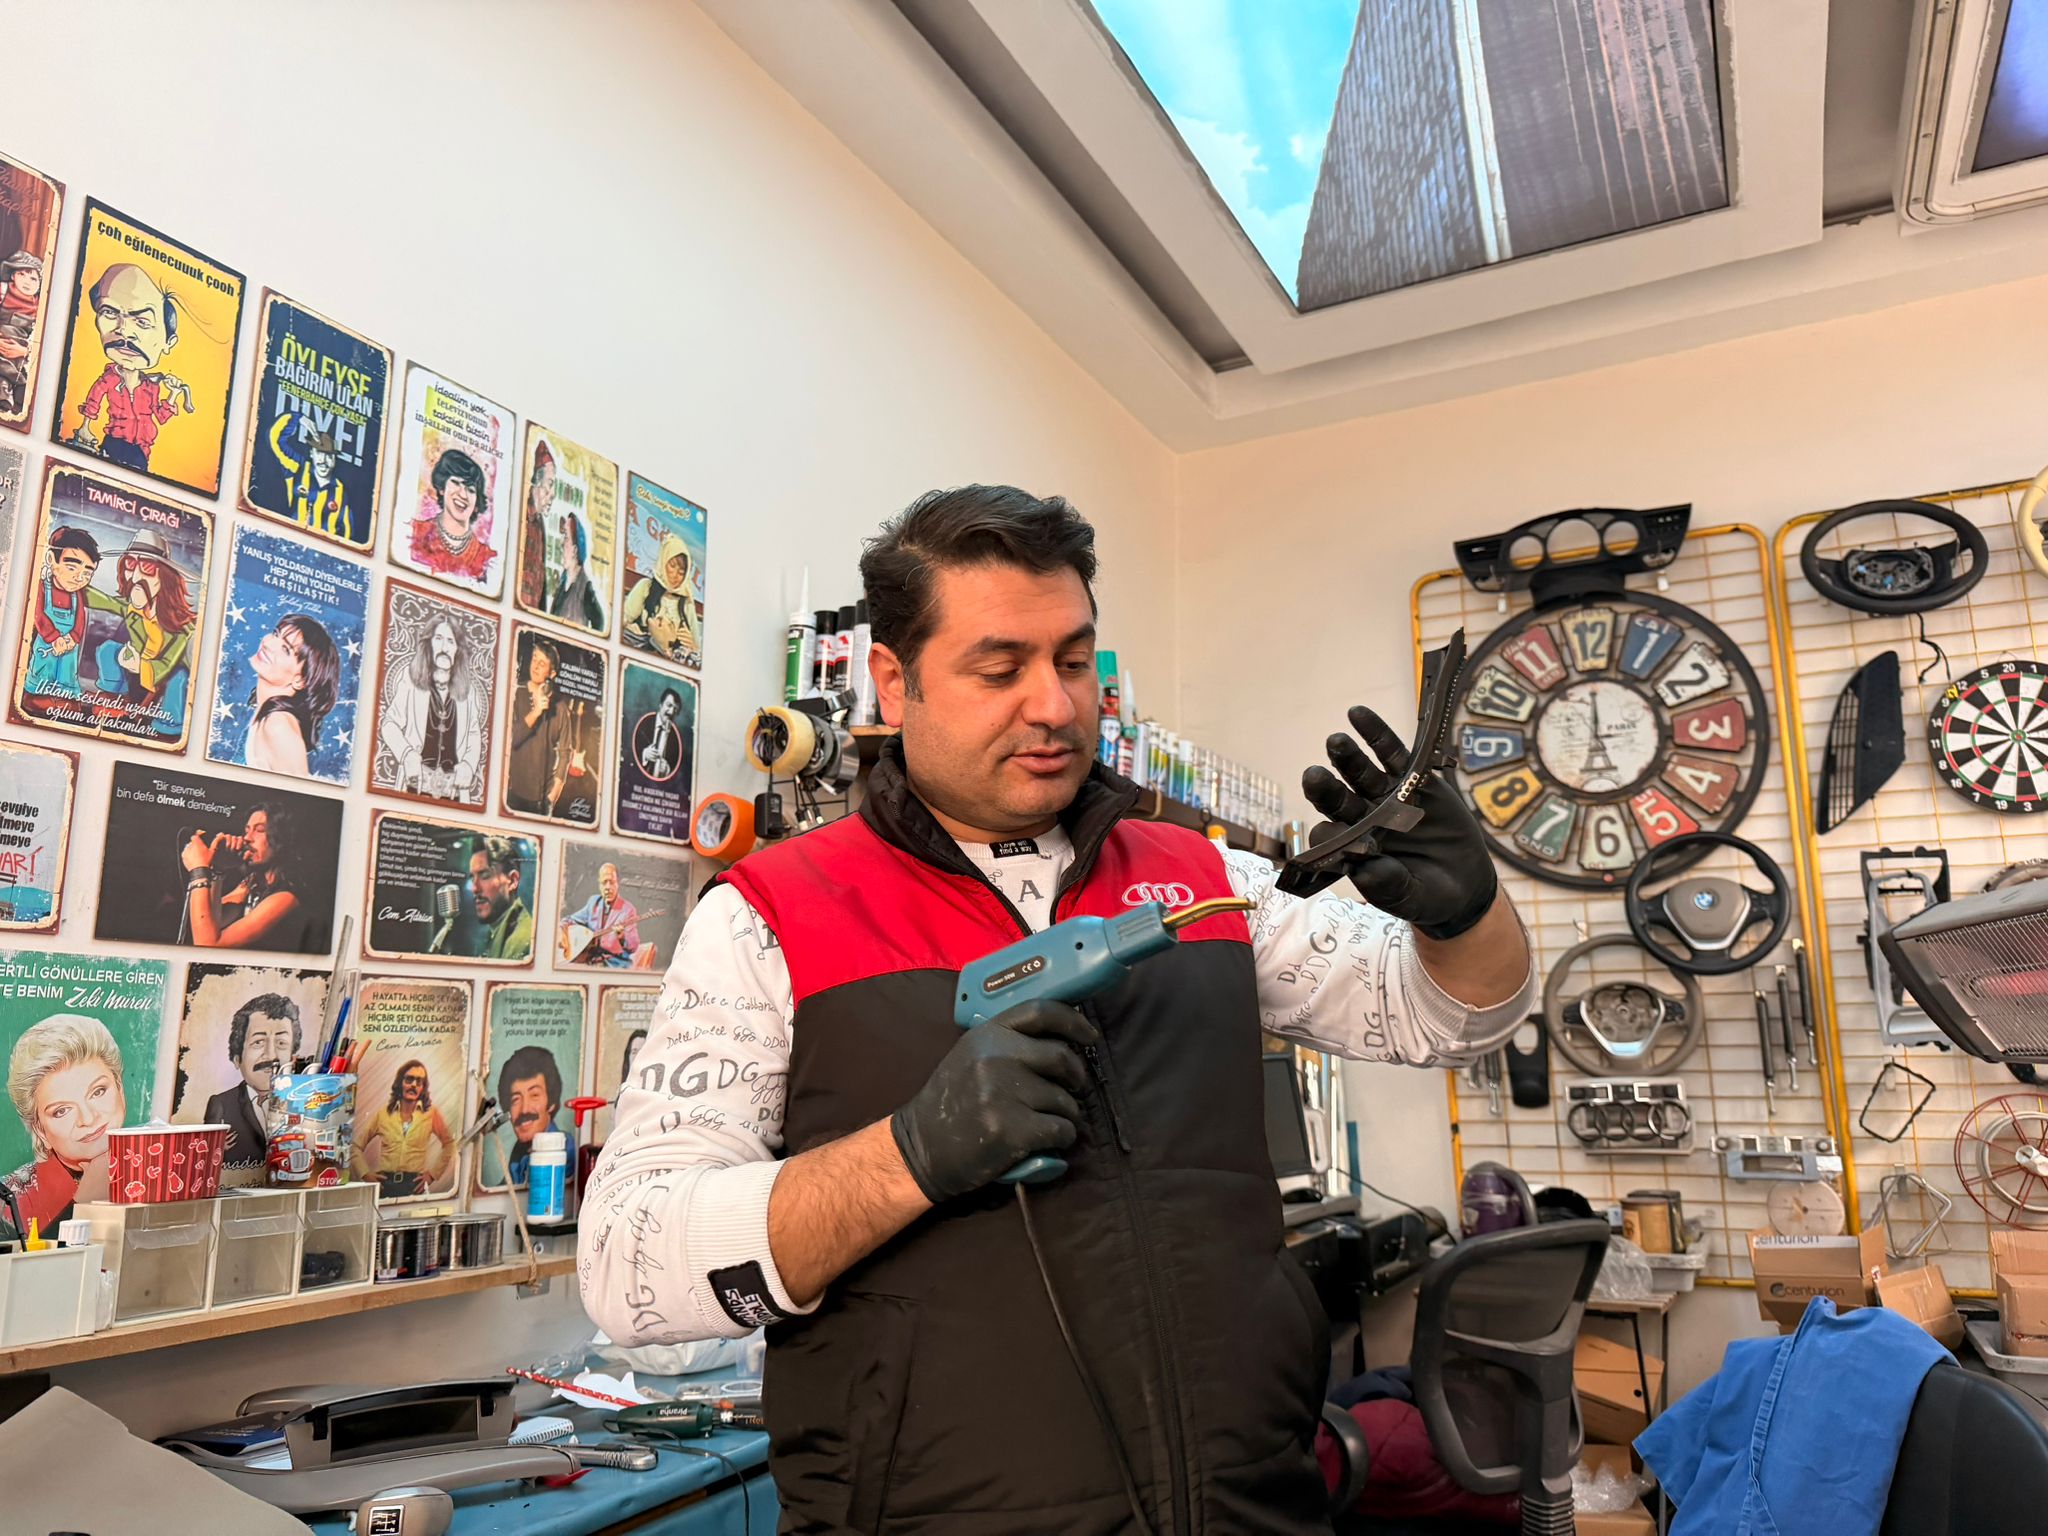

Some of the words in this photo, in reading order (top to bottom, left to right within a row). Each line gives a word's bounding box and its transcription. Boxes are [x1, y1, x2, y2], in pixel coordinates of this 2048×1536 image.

[98, 221, 122, 241] çoh
[124, 235, 204, 282] eğlenecuuuk
[206, 275, 235, 297] çooh
[275, 355, 334, 400] BAĞIRIN
[336, 385, 373, 418] ULAN
[433, 409, 465, 430] taksidi
[465, 424, 490, 442] bitsin
[86, 487, 136, 516] TAMİRCİ
[139, 506, 180, 529] ÇIRAĞI
[242, 545, 272, 564] YANLIŞ
[273, 555, 314, 577] YOLDASIN
[315, 569, 363, 593] DİYENLERLE
[270, 565, 288, 578] HEP
[289, 572, 308, 586] AYNI
[309, 578, 336, 594] YOLDA
[263, 574, 340, 606] KARŞILAŞTIK!
[1573, 620, 1606, 661] 12
[1632, 632, 1661, 670] 1
[1513, 641, 1558, 684] 11
[2002, 663, 2016, 673] 20
[2031, 664, 2038, 673] 1
[1665, 662, 1710, 699] 2
[1981, 669, 1989, 679] 5
[1957, 681, 1968, 691] 12
[35, 678, 78, 700] Ustam
[75, 690, 124, 711] seslendi
[125, 699, 174, 724] uzaktan,
[1481, 679, 1528, 717] 10
[1942, 698, 1950, 707] 9
[46, 704, 86, 722] oğlum
[1931, 718, 1942, 728] 14
[1688, 715, 1732, 741] 3
[1473, 736, 1513, 758] 9
[1931, 739, 1941, 749] 11
[1938, 760, 1947, 770] 8
[1674, 765, 1722, 795] 4
[1951, 778, 1963, 789] 16
[116, 787, 131, 799] bin
[133, 790, 155, 802] defa
[156, 794, 186, 808] ölmek
[171, 784, 206, 798] sevmek
[1491, 777, 1529, 808] 8
[0, 800, 39, 818] evgiye
[1995, 800, 2008, 810] 19
[2024, 802, 2032, 812] 3
[1532, 803, 1569, 840] 7
[1637, 794, 1679, 837] 5
[0, 832, 31, 848] meye
[1594, 815, 1621, 857] 6
[1018, 879, 1044, 902] A
[378, 906, 401, 920] Cem
[400, 908, 433, 923] Adrian
[40, 965, 122, 983] GÖNÜLLERE
[125, 970, 165, 985] GİREN
[17, 983, 63, 999] BENİM
[65, 986, 104, 1008] Zeki
[103, 989, 153, 1010] Müren
[372, 991, 407, 1001] HAYATTA
[364, 1003, 375, 1011] AZ
[378, 1003, 410, 1012] OLMADI
[367, 1013, 394, 1023] HİÇBİR
[428, 1026, 456, 1034] KADAR
[319, 1177, 338, 1186] STOP
[1785, 1285, 1845, 1297] centurion
[659, 1405, 688, 1416] Piranha
